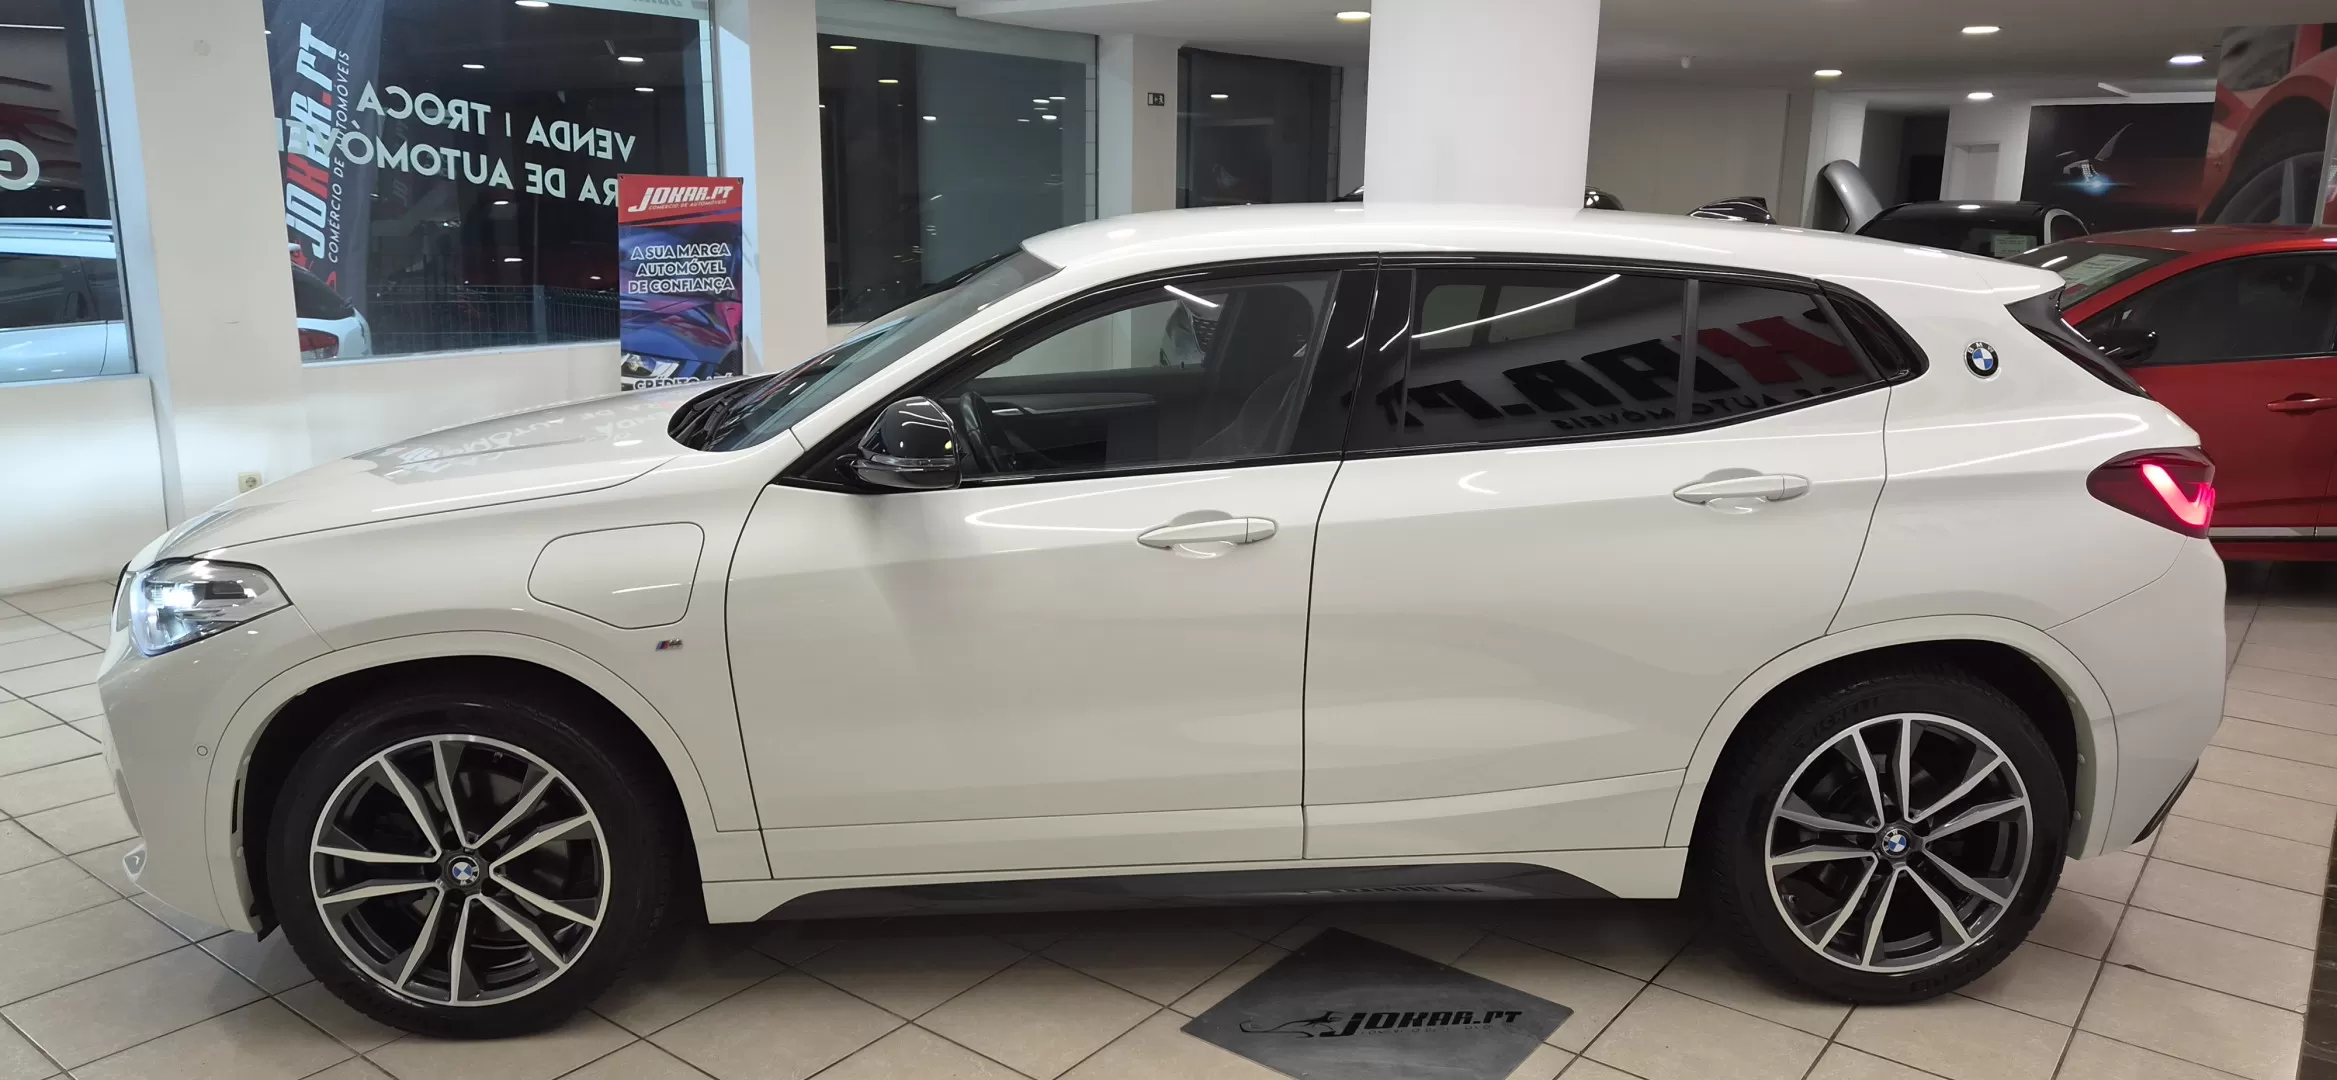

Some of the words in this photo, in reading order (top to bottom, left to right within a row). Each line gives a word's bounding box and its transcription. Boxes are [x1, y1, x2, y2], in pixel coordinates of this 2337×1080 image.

[333, 156, 345, 178] DE
[628, 186, 734, 212] JOKAR.PT
[328, 183, 343, 263] COMÉRCIO
[631, 246, 644, 260] A
[645, 245, 676, 260] SUA
[677, 243, 731, 258] MARCA
[636, 258, 727, 277] AUTOMÓVEL
[628, 280, 648, 294] DE
[649, 277, 735, 294] CONFIANÇA
[1320, 1010, 1523, 1037] JOKAR.PT
